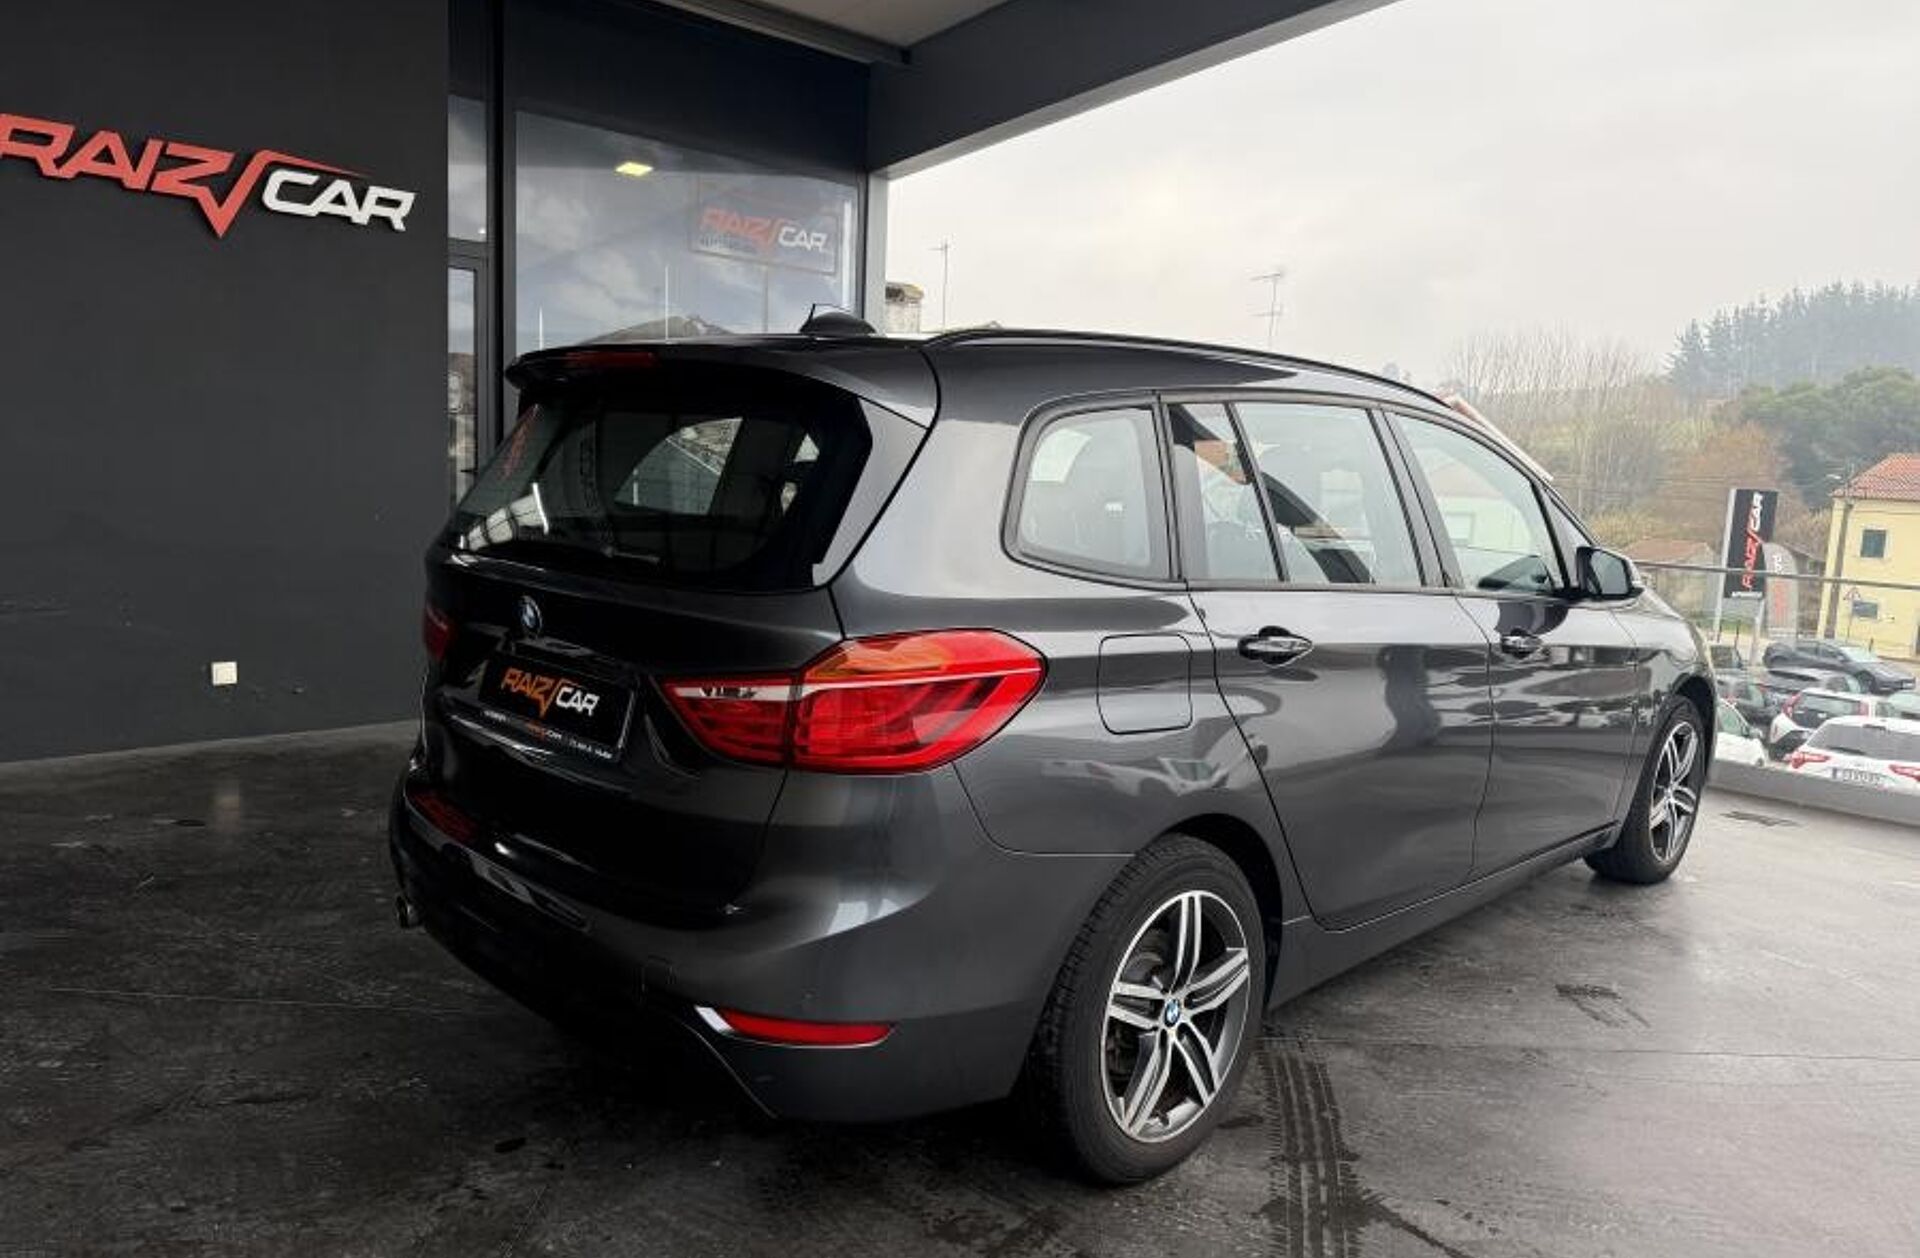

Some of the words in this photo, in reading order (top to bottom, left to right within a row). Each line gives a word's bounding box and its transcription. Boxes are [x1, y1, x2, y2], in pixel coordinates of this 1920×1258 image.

[262, 168, 416, 231] CAR
[778, 225, 828, 252] CAR
[555, 686, 600, 716] CAR
